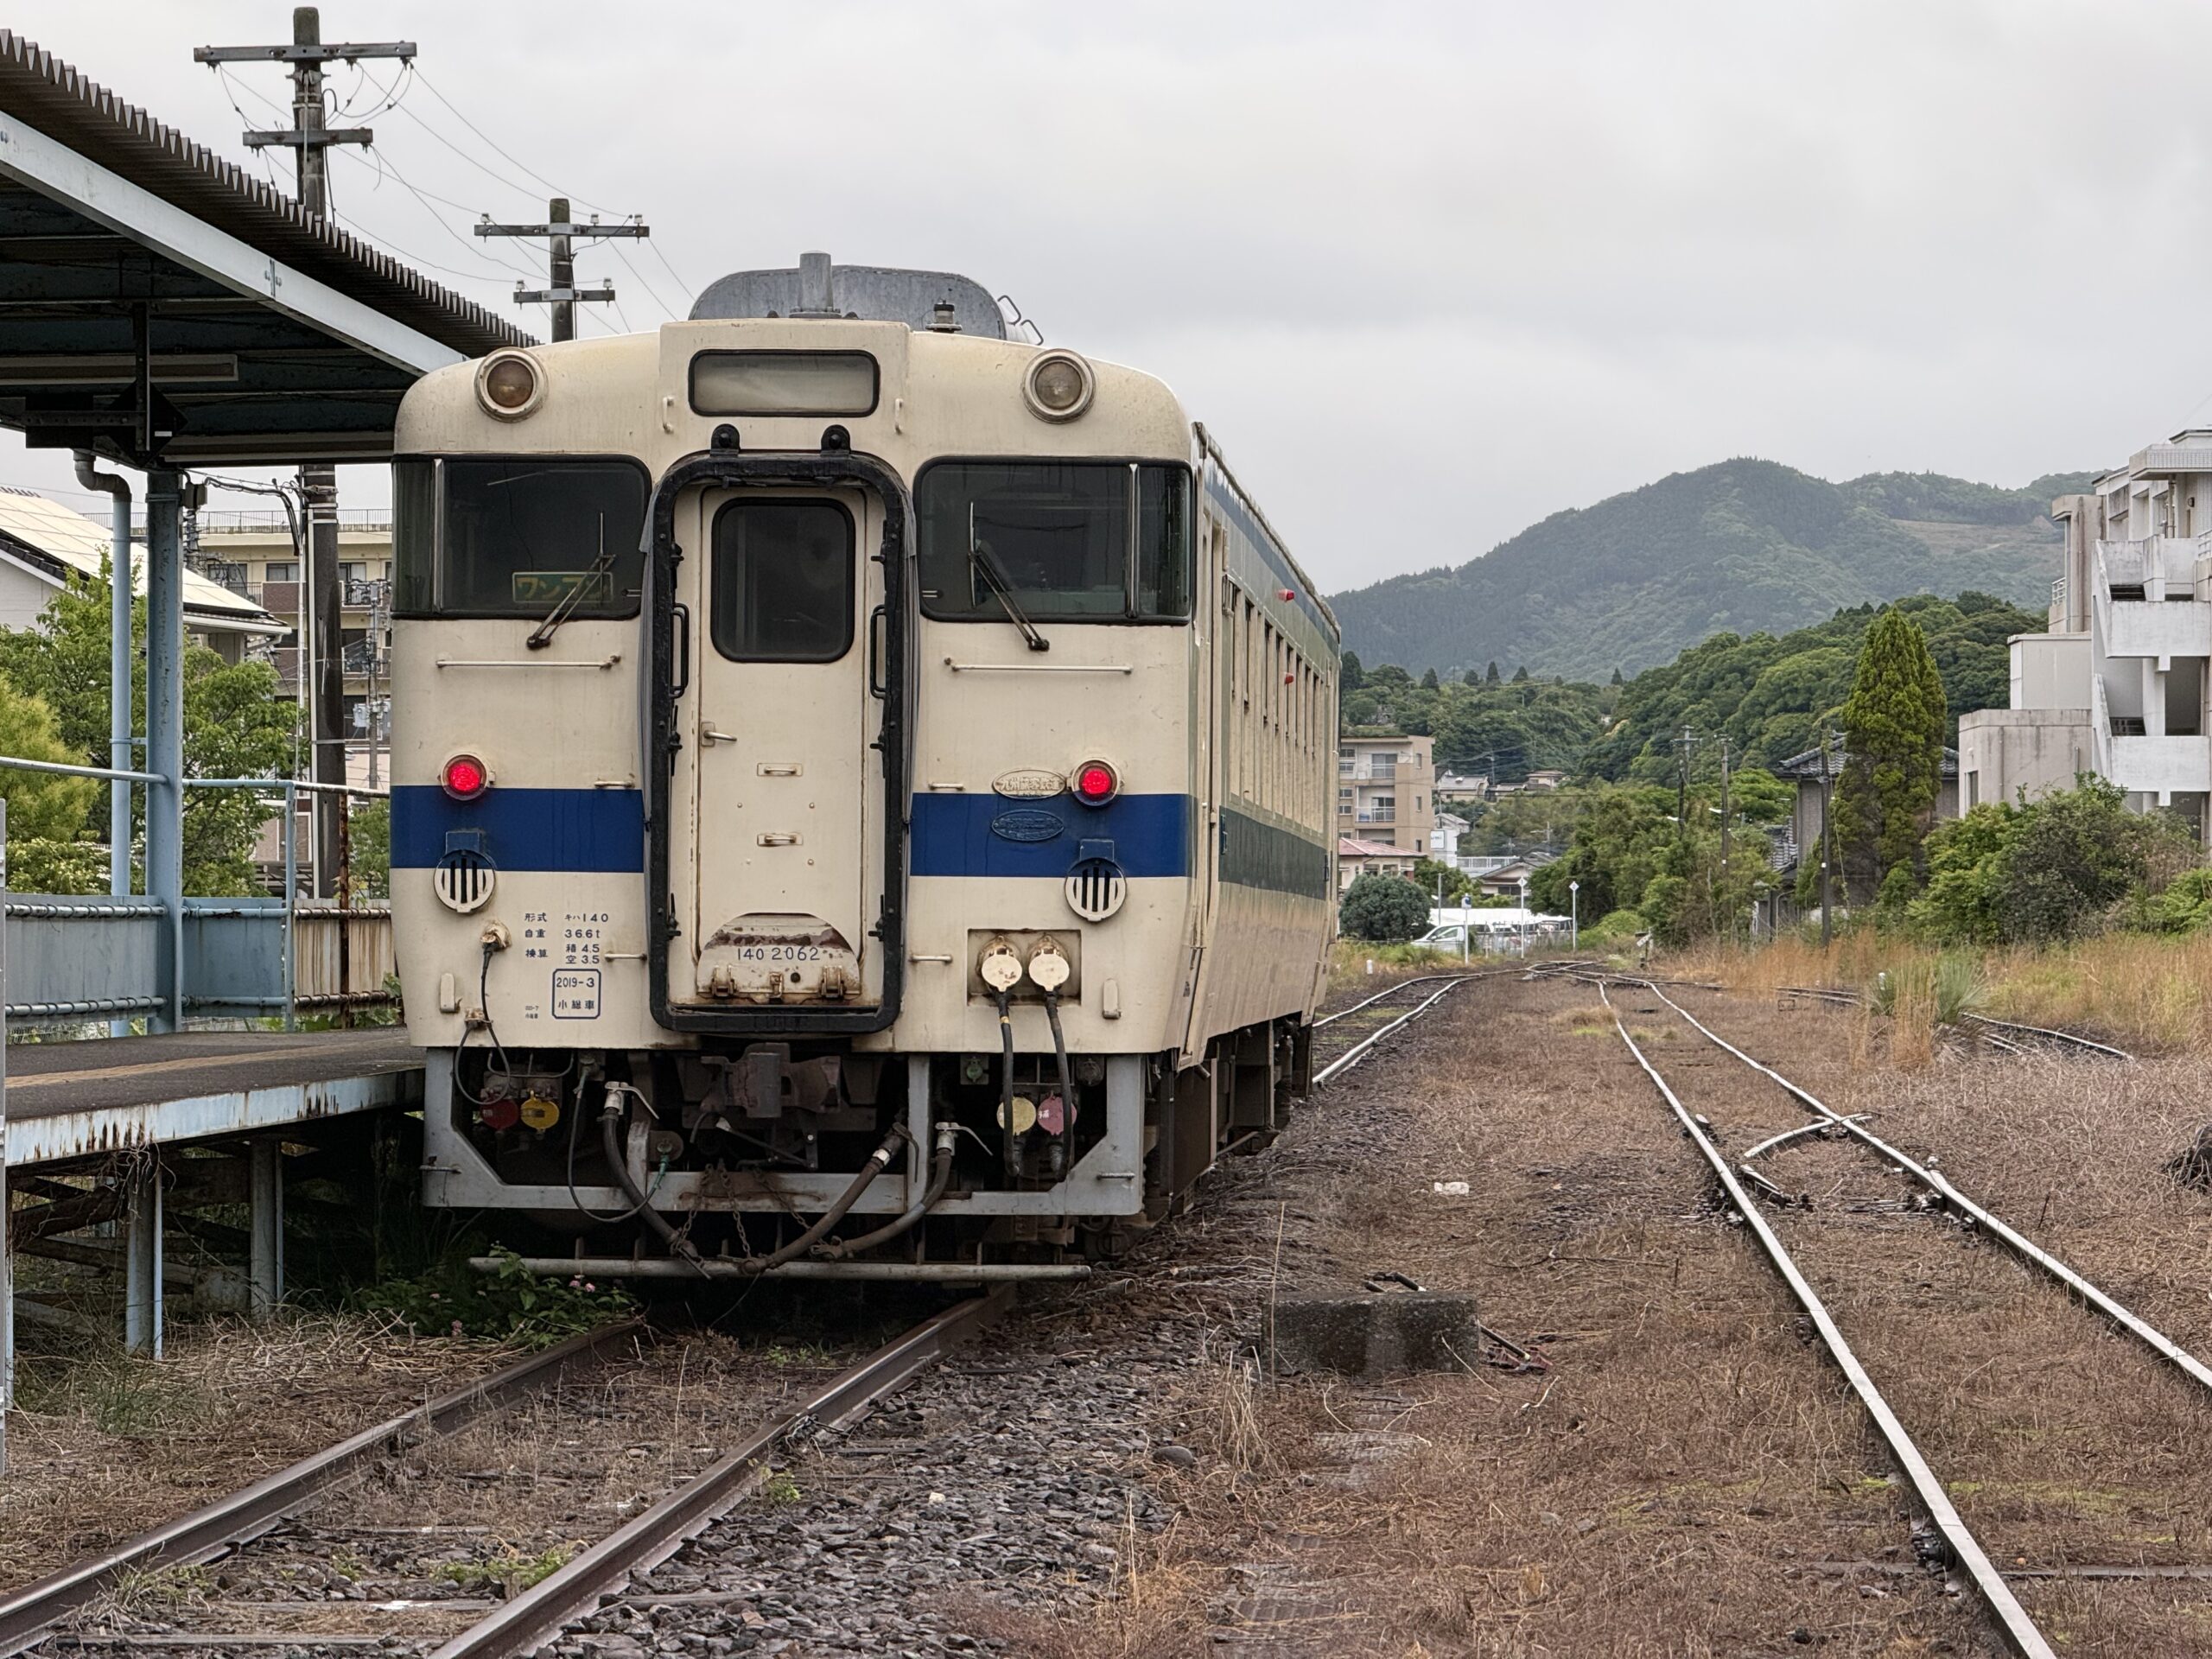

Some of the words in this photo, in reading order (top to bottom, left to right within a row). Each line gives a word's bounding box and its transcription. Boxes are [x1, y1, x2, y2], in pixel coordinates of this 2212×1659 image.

[524, 912, 547, 923] 形式
[564, 912, 609, 923] キハ140
[524, 928, 546, 938] 自重
[565, 955, 576, 964] 空
[737, 947, 765, 961] 140
[772, 947, 820, 961] 2062
[556, 977, 595, 988] 2019-3
